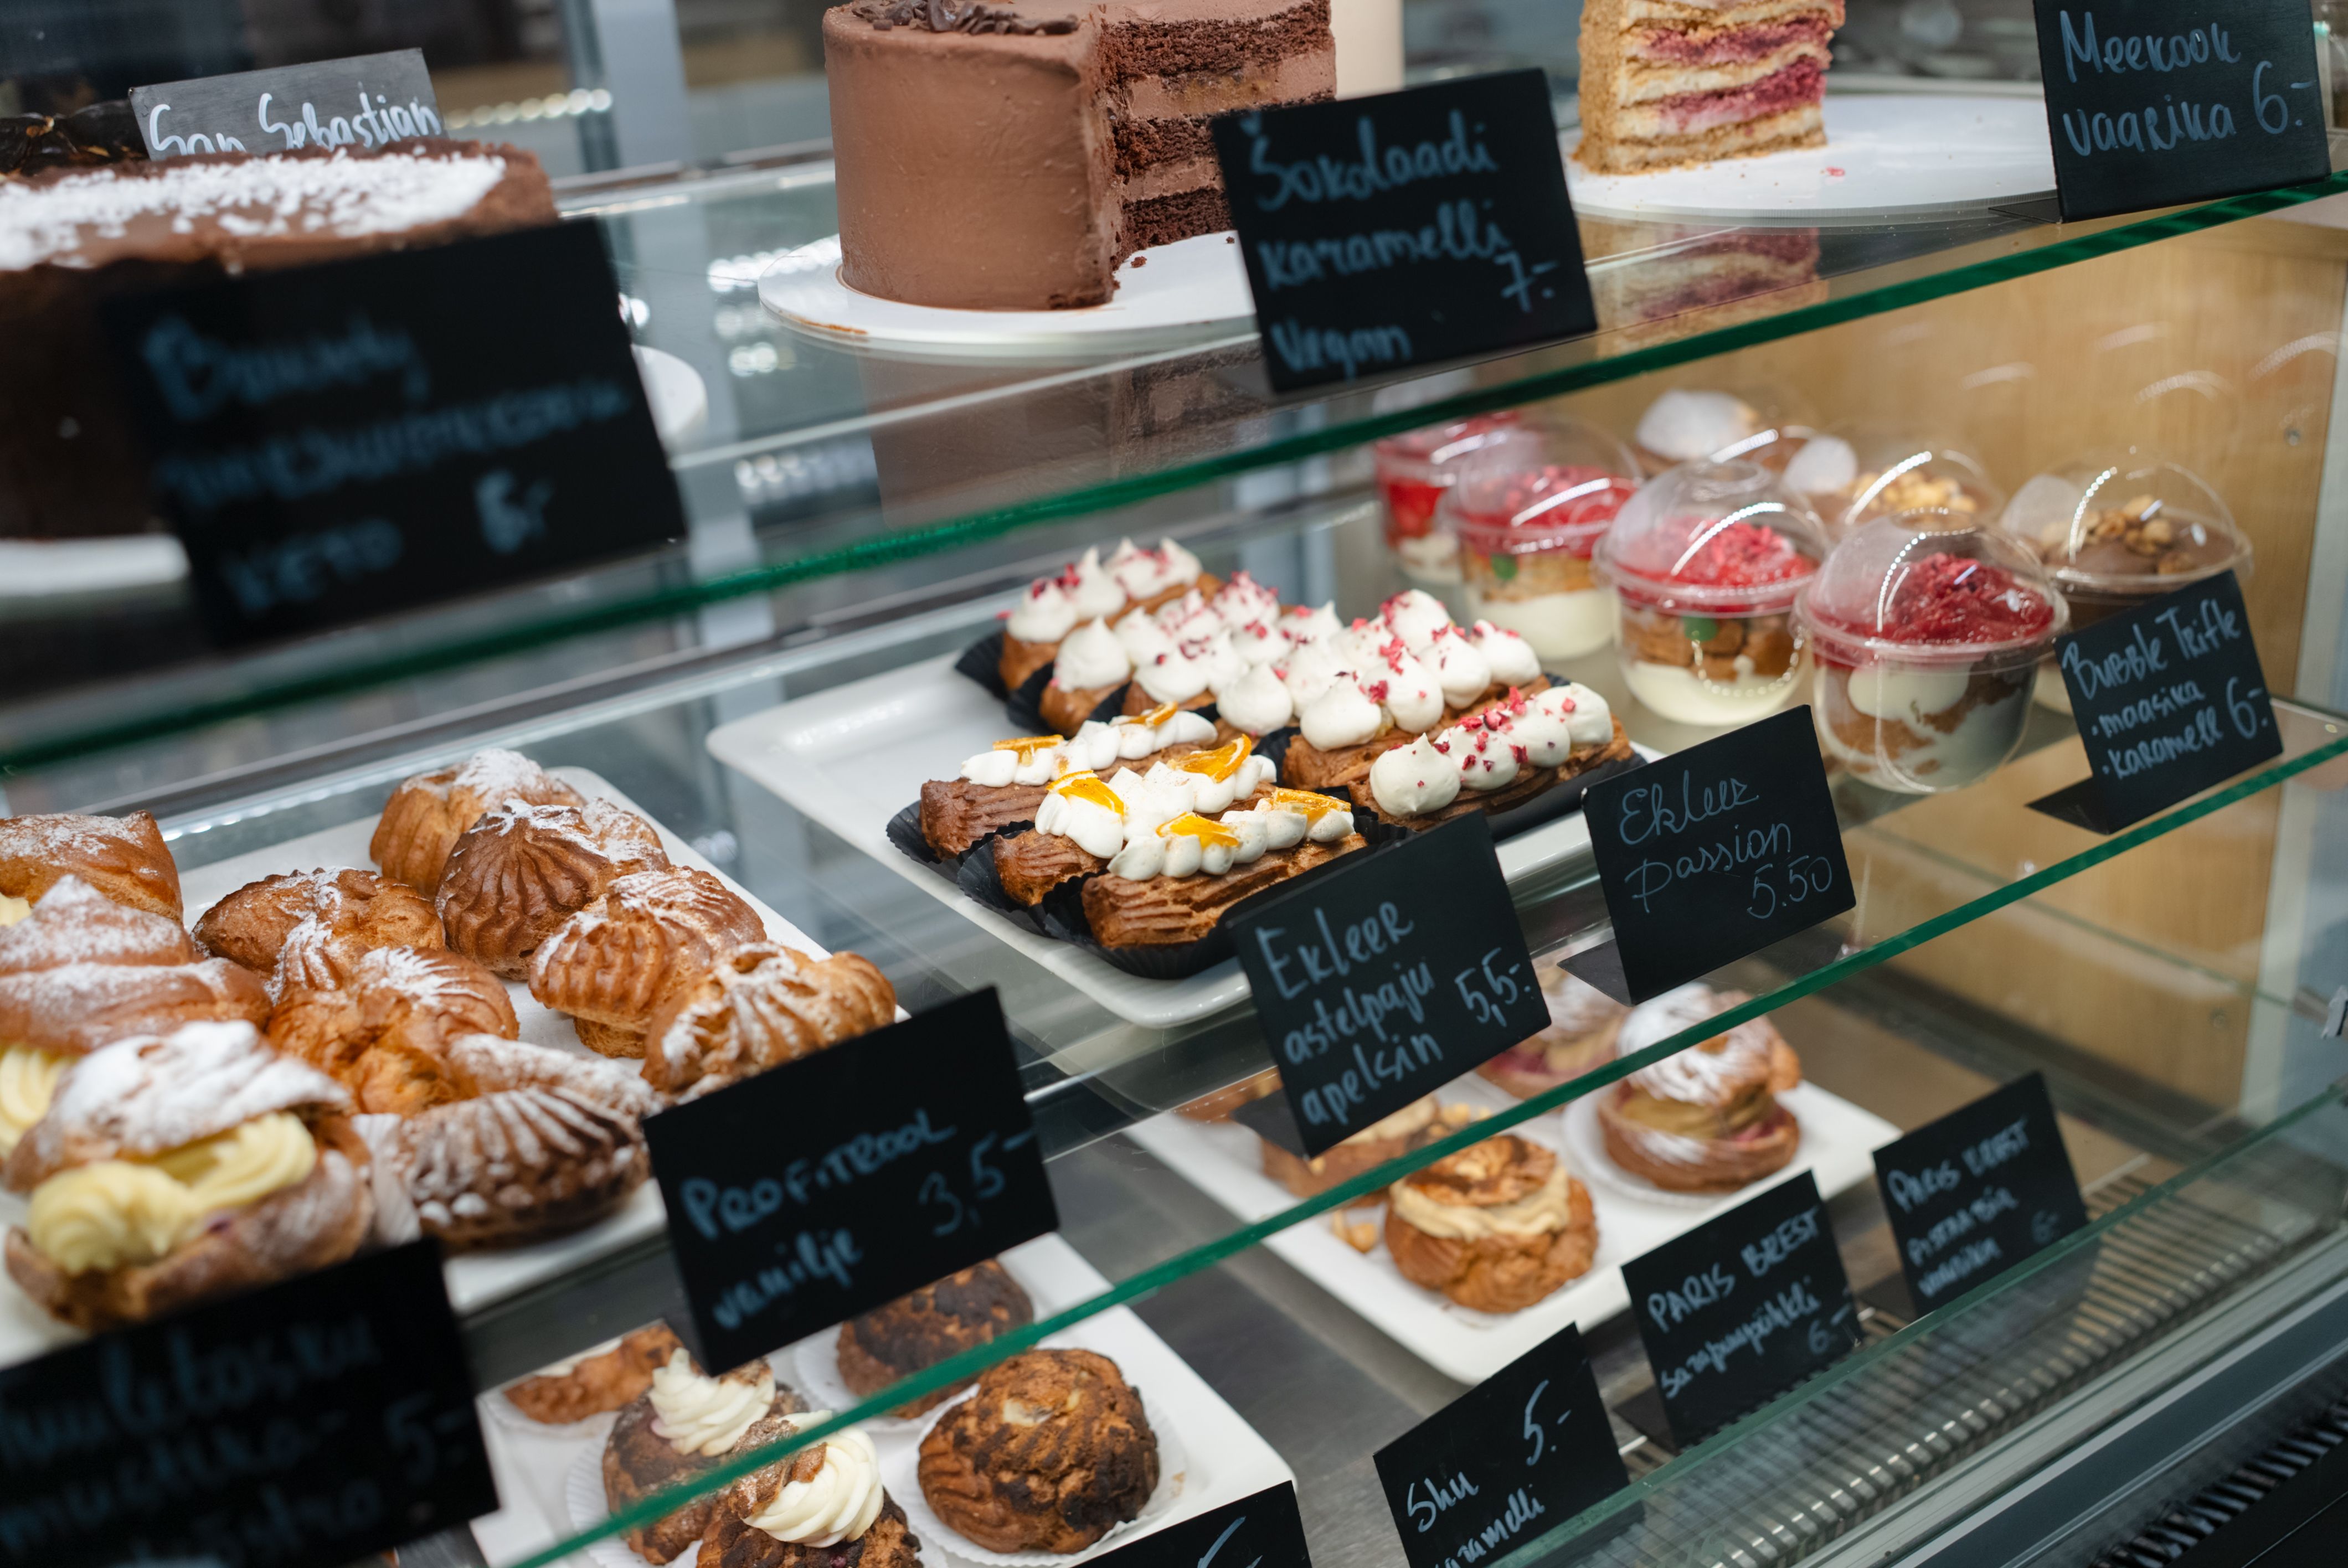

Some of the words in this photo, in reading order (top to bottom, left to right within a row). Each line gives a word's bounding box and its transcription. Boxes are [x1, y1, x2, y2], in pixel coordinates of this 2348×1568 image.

[258, 81, 442, 151] Sebastian
[1747, 855, 1832, 919] 5.50
[1284, 959, 1435, 1064] astelpaju
[1301, 1033, 1443, 1125] apelsin
